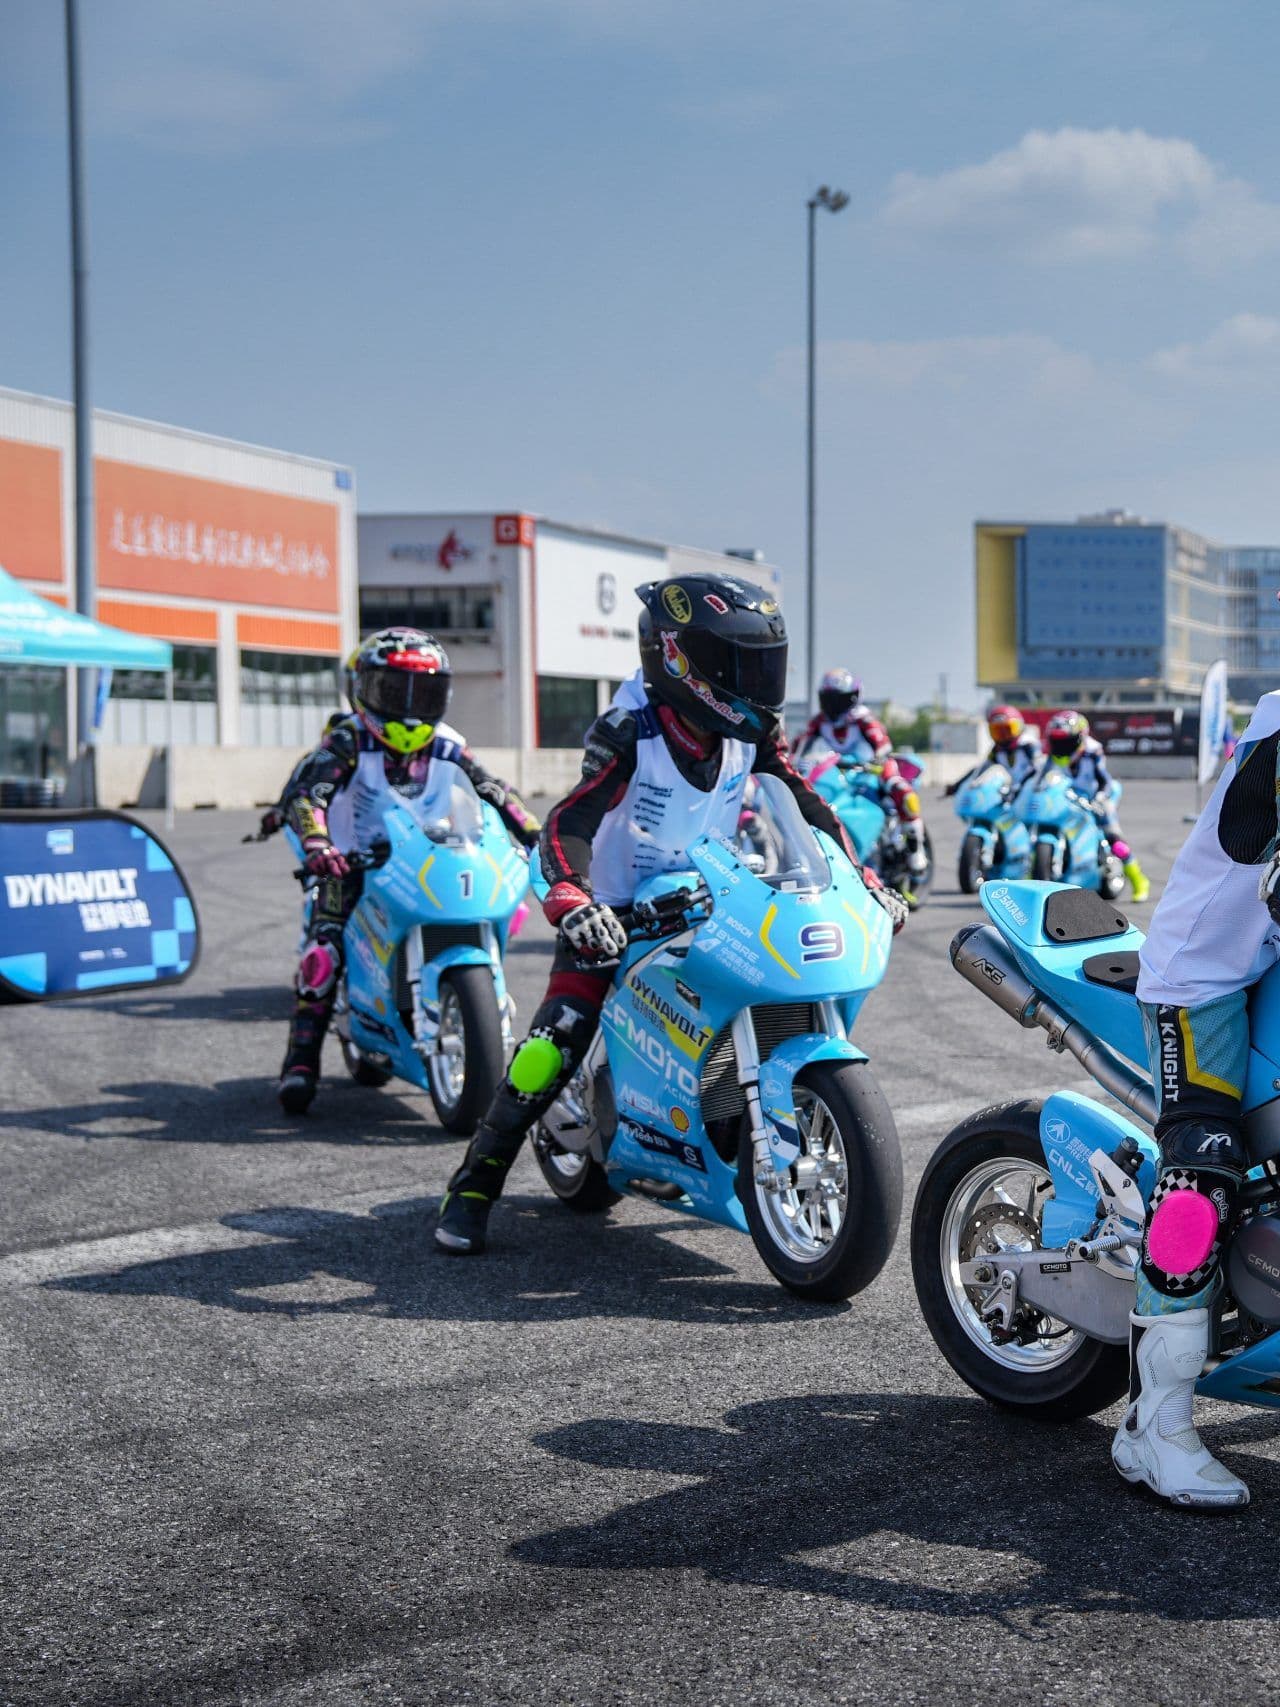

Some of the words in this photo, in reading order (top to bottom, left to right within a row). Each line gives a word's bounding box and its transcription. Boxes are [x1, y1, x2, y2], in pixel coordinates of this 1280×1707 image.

[4, 868, 138, 909] DYNAVOLT
[458, 872, 472, 898] 1
[801, 923, 844, 964] 9
[630, 973, 711, 1048] DYNAVOLT
[1160, 1021, 1178, 1102] KNIGHT
